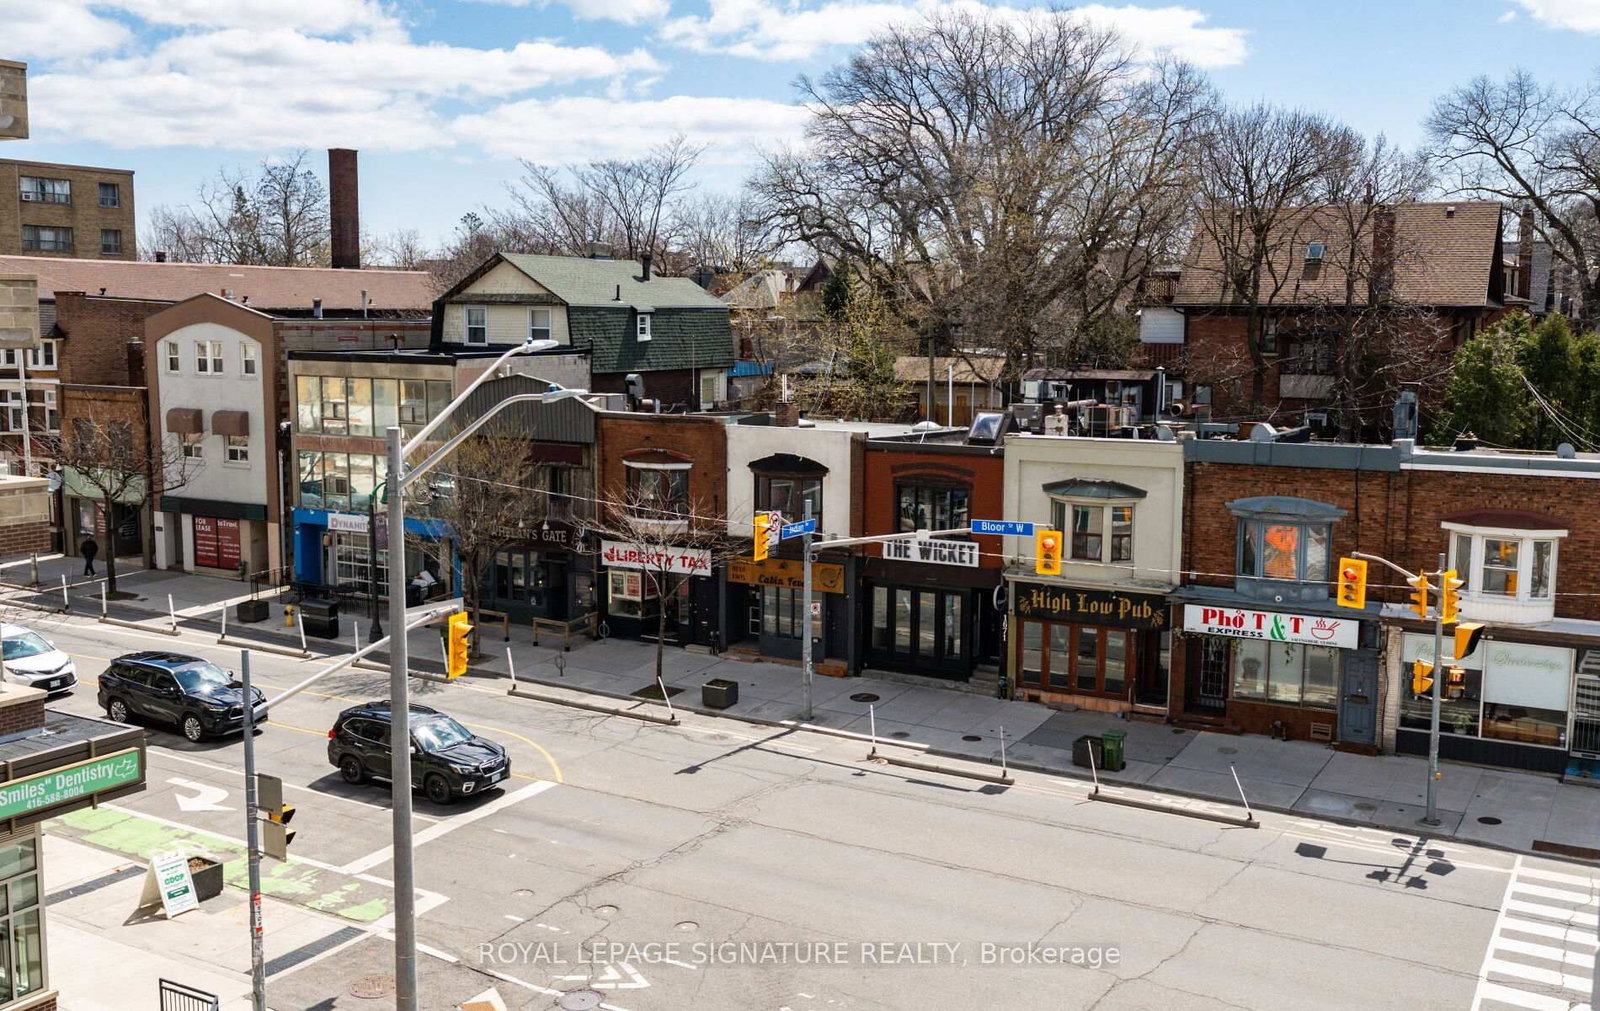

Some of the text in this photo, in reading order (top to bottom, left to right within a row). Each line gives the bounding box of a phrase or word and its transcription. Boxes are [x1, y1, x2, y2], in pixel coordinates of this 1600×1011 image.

[195, 524, 212, 532] LEASE
[331, 517, 369, 531] DYNAMIT
[981, 521, 1005, 532] Bloor
[1016, 523, 1024, 533] W
[542, 530, 567, 543] GATE
[886, 539, 976, 565] THE WICKET
[616, 549, 709, 570] LIBERTY TAX
[758, 574, 784, 585] Cabin
[1030, 588, 1152, 620] High Low Pub
[1207, 627, 1264, 638] EXPRESS
[1252, 612, 1267, 630] T
[1269, 613, 1287, 641] &
[1289, 617, 1304, 634] T
[56, 763, 115, 791] Dentistry
